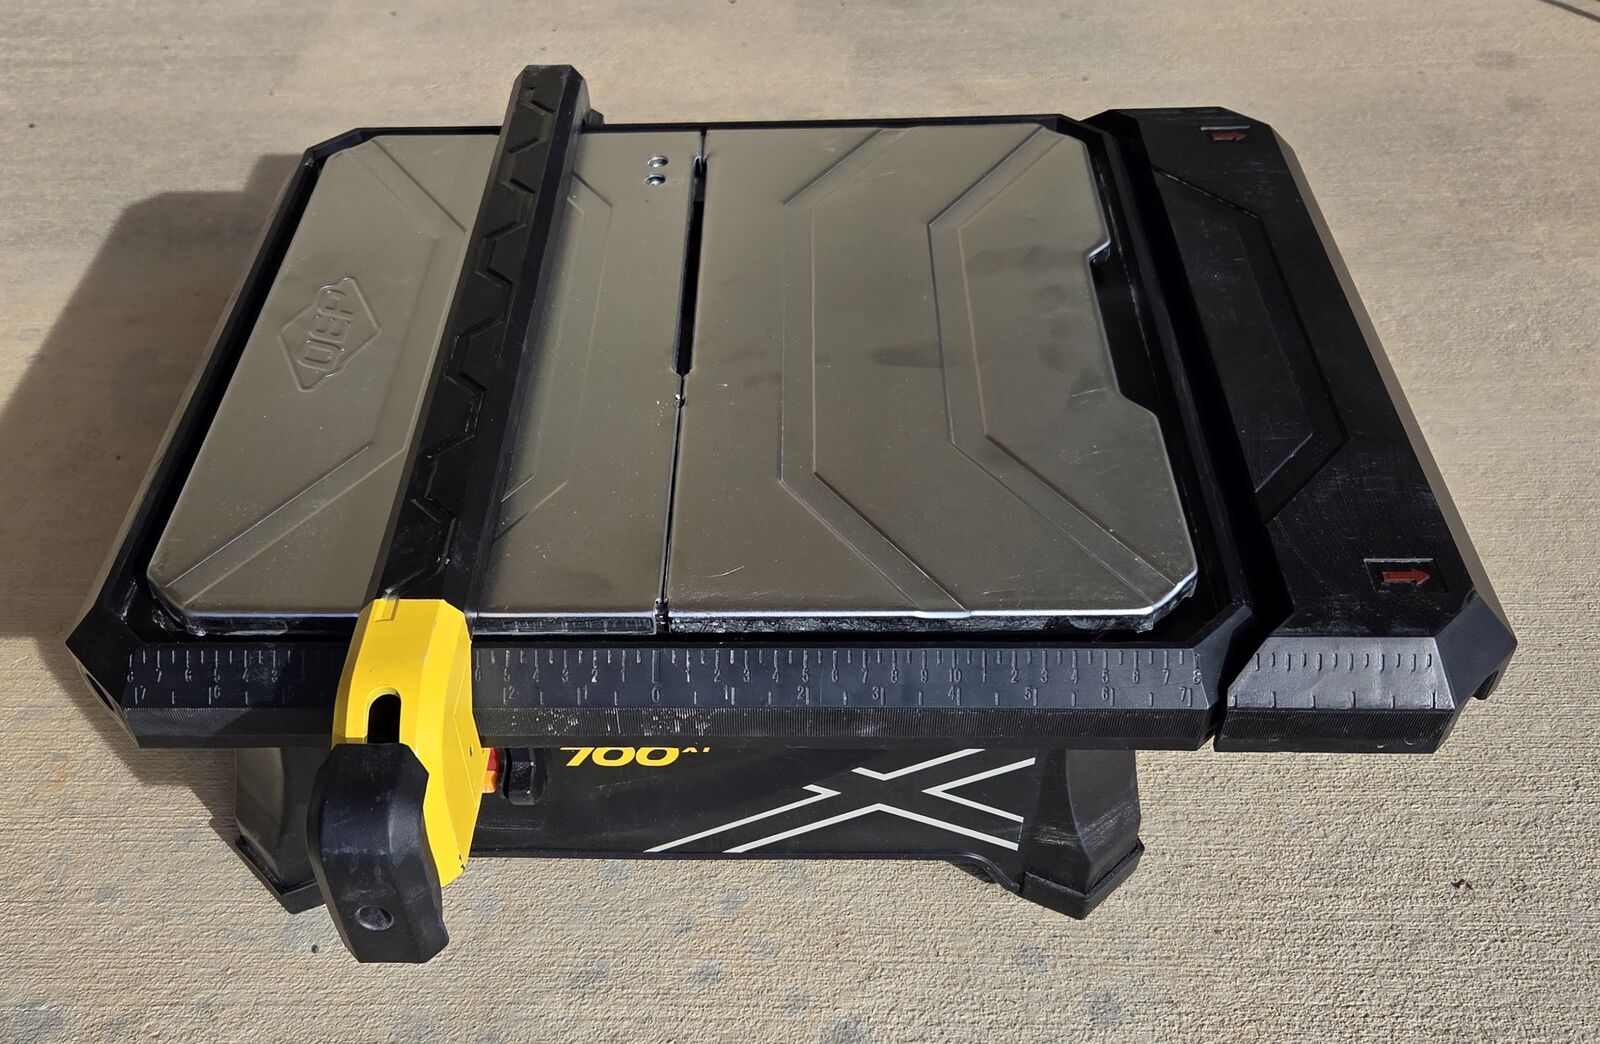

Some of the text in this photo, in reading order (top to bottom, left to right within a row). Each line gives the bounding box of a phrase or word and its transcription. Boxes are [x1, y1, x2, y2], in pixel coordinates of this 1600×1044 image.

[532, 668, 540, 683] 4
[591, 668, 600, 683] 2
[685, 668, 691, 683] 1
[713, 668, 722, 683] 2
[743, 668, 751, 683] 3
[772, 668, 780, 683] 4
[801, 668, 810, 683] 5
[831, 668, 840, 683] 6
[860, 668, 869, 683] 7
[891, 668, 899, 683] 8
[920, 668, 929, 683] 9
[948, 668, 963, 683] 10
[980, 668, 987, 684] 1
[1010, 668, 1019, 684] 2
[1040, 668, 1049, 684] 3
[1070, 668, 1079, 684] 4
[1101, 668, 1110, 684] 5
[1131, 668, 1141, 684] 6
[1162, 668, 1171, 685] 7
[1192, 669, 1202, 685] 8
[508, 685, 517, 699] 2
[651, 687, 662, 703] 0
[723, 685, 729, 700] 1
[796, 685, 806, 700] 2
[872, 685, 880, 700] 3
[947, 686, 957, 700] 4
[1024, 686, 1033, 701] 5
[1101, 686, 1110, 701] 6
[1178, 686, 1187, 701] 7
